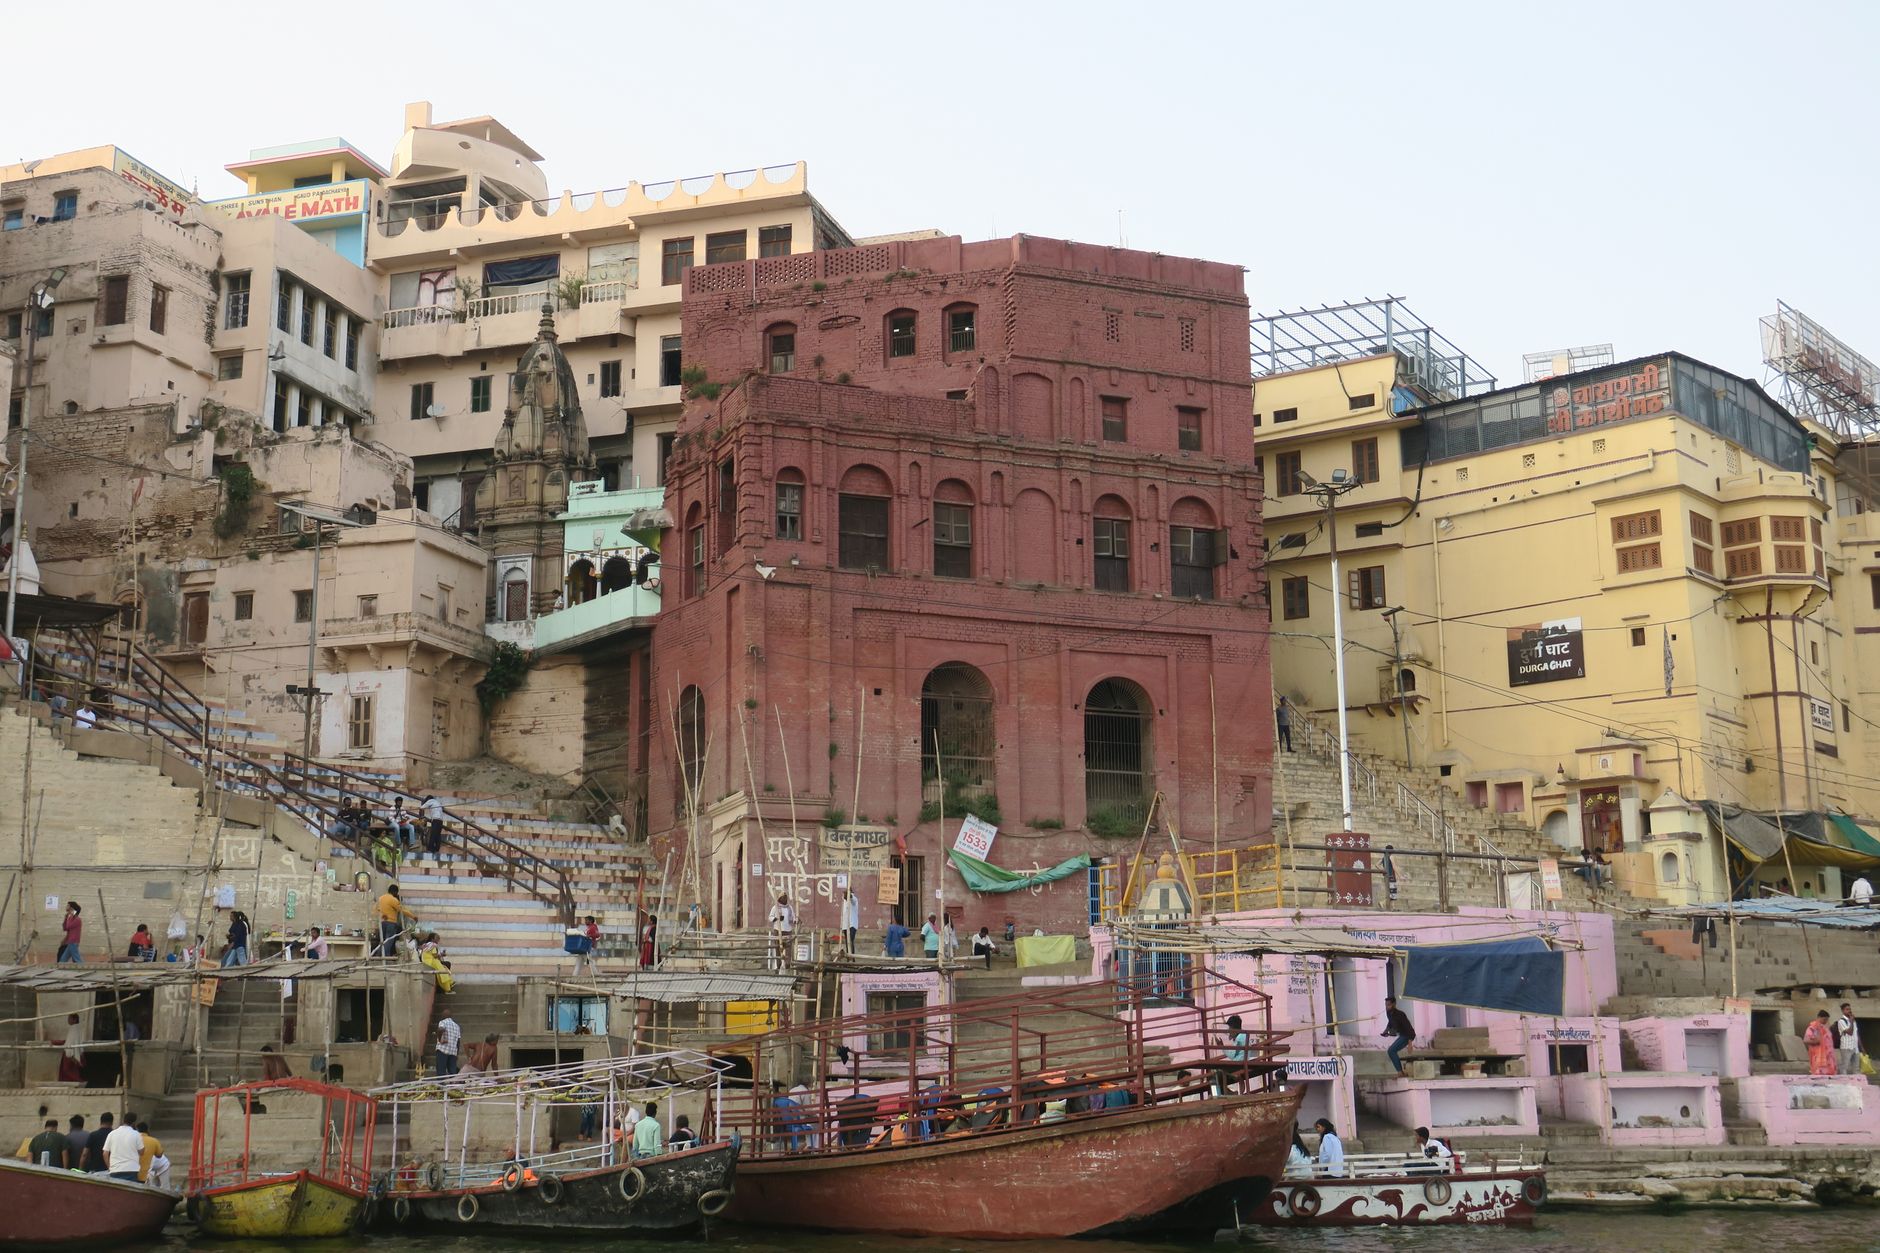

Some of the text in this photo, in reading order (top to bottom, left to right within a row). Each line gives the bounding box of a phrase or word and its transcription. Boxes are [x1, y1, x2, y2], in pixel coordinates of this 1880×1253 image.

[301, 195, 359, 217] MATH
[1545, 642, 1570, 656] घाट
[1519, 658, 1573, 674] DURGA GHAT
[962, 831, 988, 851] 1533
[1466, 1203, 1507, 1223] काशी
